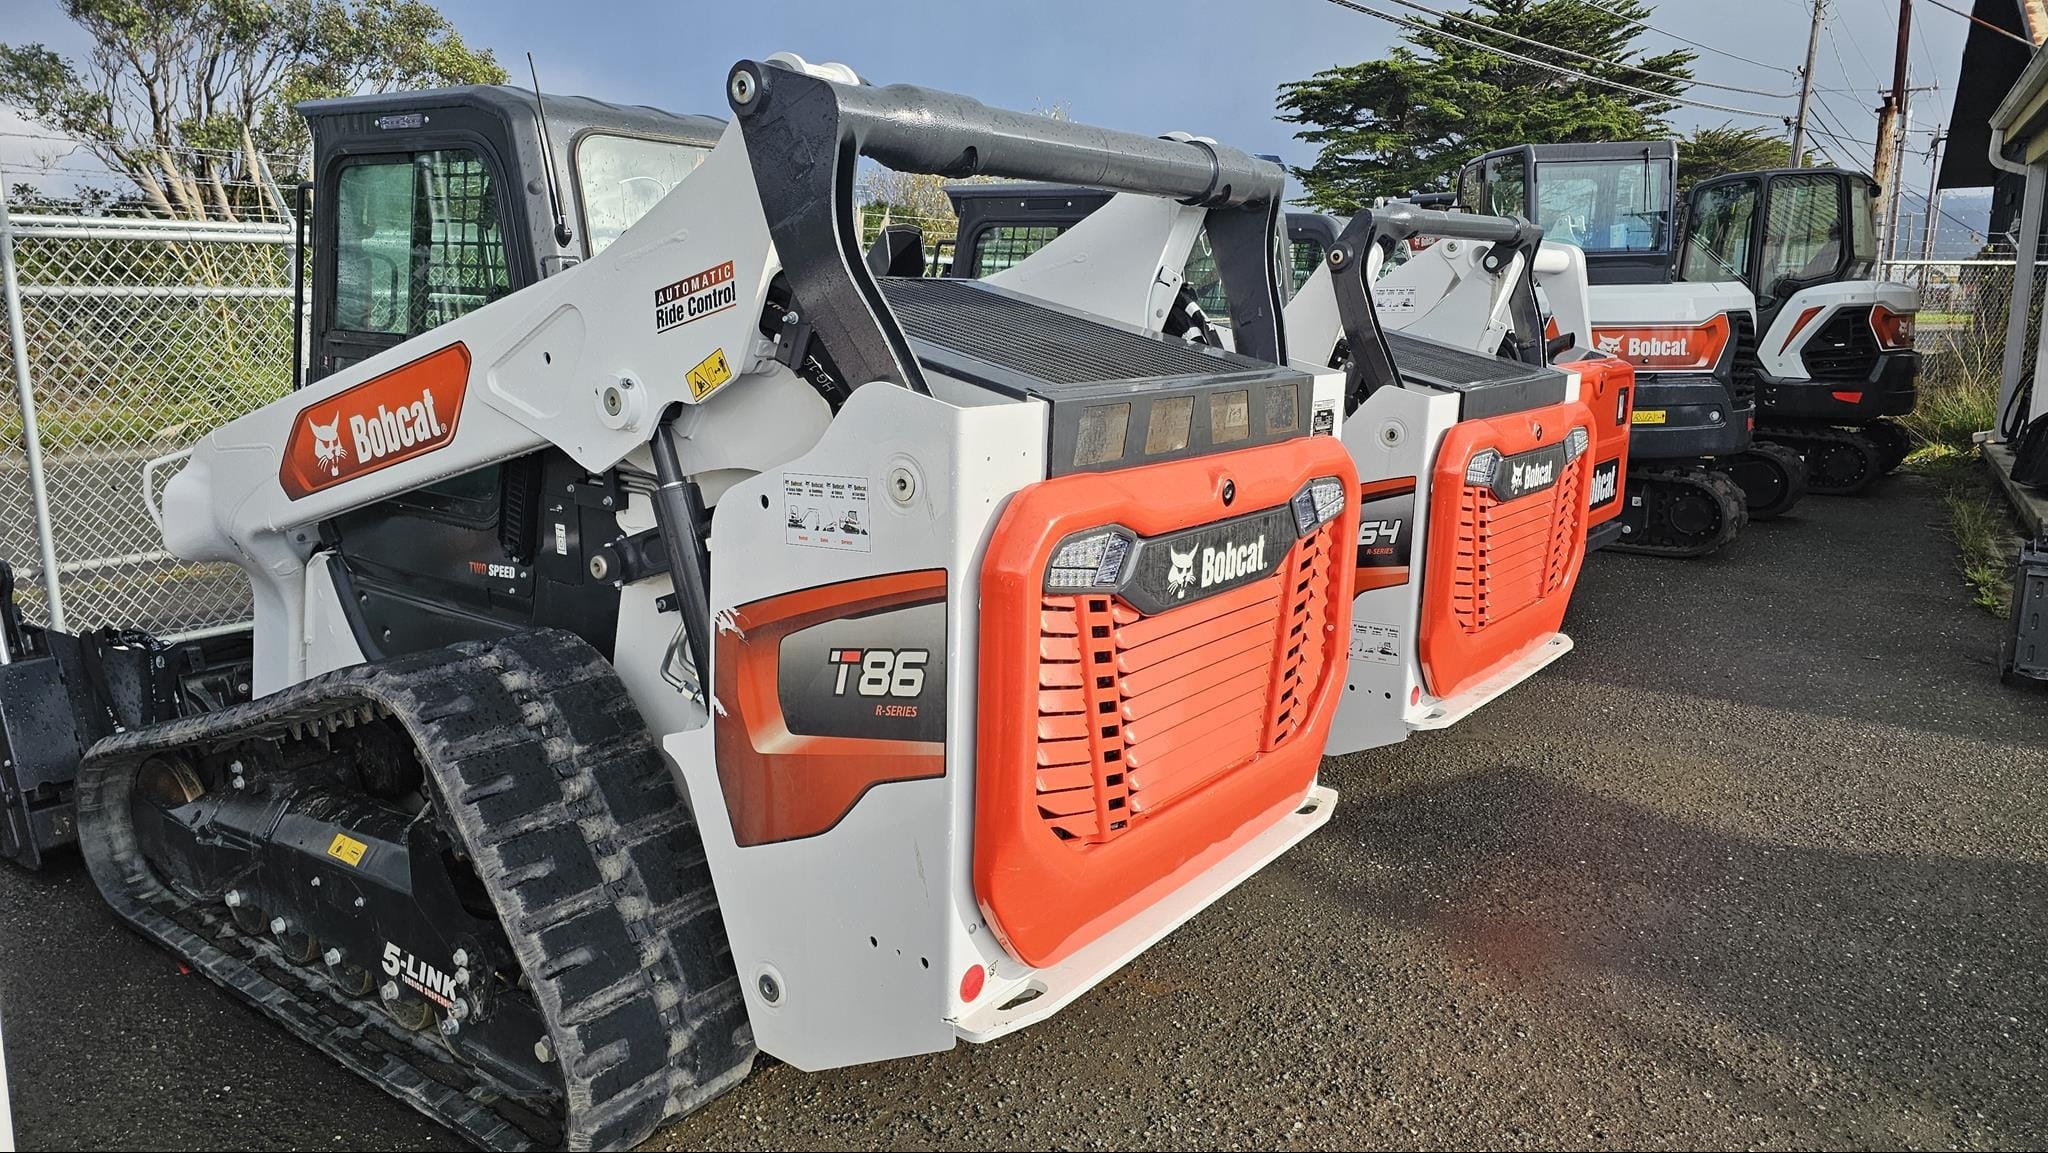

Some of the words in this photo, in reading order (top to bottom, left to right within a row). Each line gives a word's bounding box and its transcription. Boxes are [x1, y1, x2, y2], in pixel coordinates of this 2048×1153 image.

[658, 264, 731, 304] AUTOMATIC
[656, 303, 685, 329] Ride
[688, 281, 736, 316] Control
[1357, 520, 1401, 546] 64
[468, 561, 487, 575] TWO
[488, 563, 516, 579] SPEED
[829, 649, 928, 697] T86
[875, 704, 918, 717] R-SERIES
[381, 941, 457, 1002] 5-LINK
